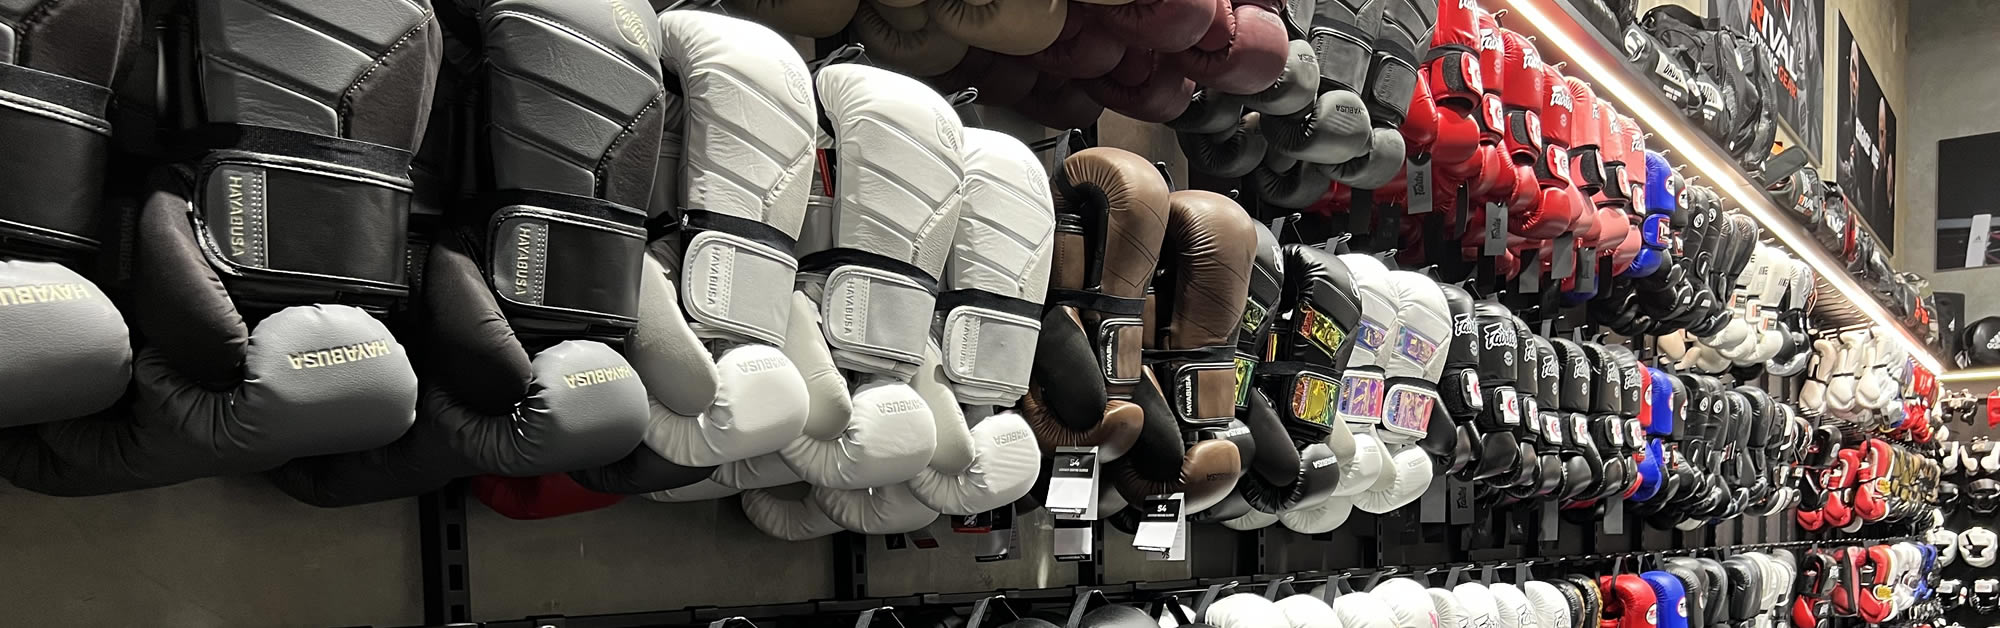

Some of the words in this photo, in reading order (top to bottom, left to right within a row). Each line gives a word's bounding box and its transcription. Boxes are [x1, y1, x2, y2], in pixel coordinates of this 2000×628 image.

[1751, 0, 1798, 81] RIVAL
[1777, 65, 1798, 100] GEAR
[228, 175, 244, 257] HAYABUSA
[515, 226, 531, 295] HAYABUSA
[706, 247, 721, 306] HAYABUSA
[844, 281, 855, 335] HAYABUSA
[287, 339, 391, 370] HAYABUSA
[959, 319, 971, 368] HAYABUSA
[1107, 330, 1115, 376] HAYABUSA
[563, 366, 633, 389] HAYABUSA
